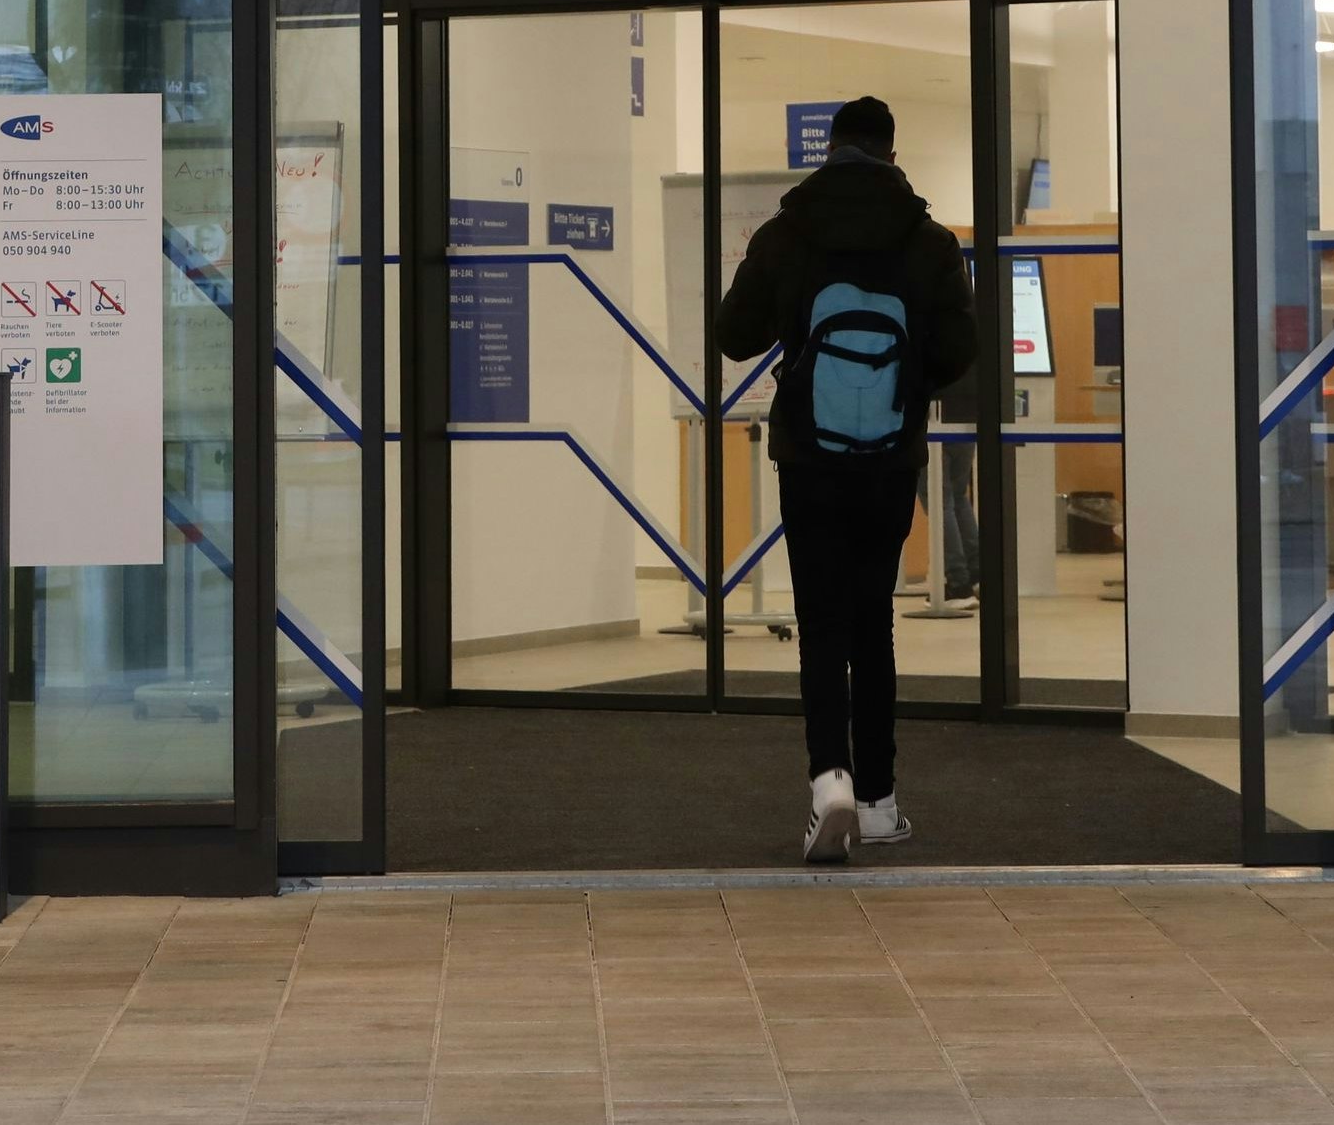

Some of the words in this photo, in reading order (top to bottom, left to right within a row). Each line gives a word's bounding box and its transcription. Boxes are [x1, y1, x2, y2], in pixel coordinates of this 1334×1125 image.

[12, 121, 54, 133] AMS
[802, 128, 826, 138] Bitte
[802, 152, 828, 163] ziehe
[2, 169, 89, 182] Öffnungszeiten
[125, 184, 145, 195] Uhr
[2, 201, 13, 211] Fr
[125, 199, 145, 210] Uhr
[2, 230, 95, 241] AMS-ServiceLine
[2, 246, 24, 256] 050
[26, 245, 47, 256] 904
[50, 245, 72, 255] 940
[1013, 265, 1032, 273] UNG
[45, 321, 63, 329] Tiere
[90, 329, 121, 337] verboten
[45, 389, 87, 397] Defibrillator
